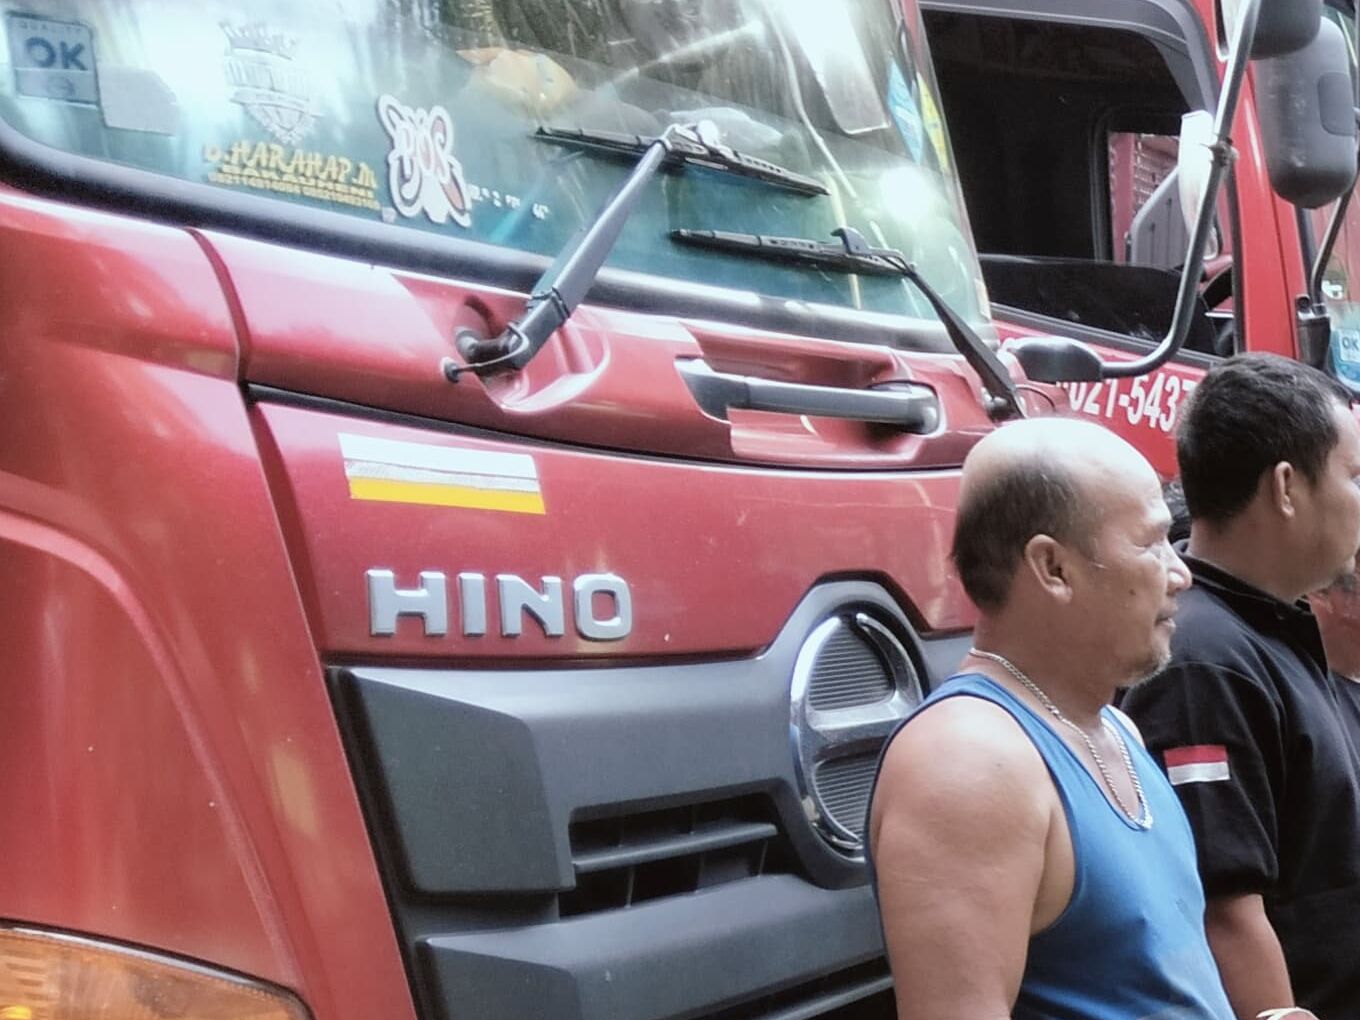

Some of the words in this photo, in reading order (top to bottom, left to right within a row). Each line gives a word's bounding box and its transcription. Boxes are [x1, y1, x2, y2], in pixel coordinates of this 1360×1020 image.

[26, 37, 88, 71] OK
[1342, 336, 1359, 352] OK
[366, 568, 633, 642] HINO
